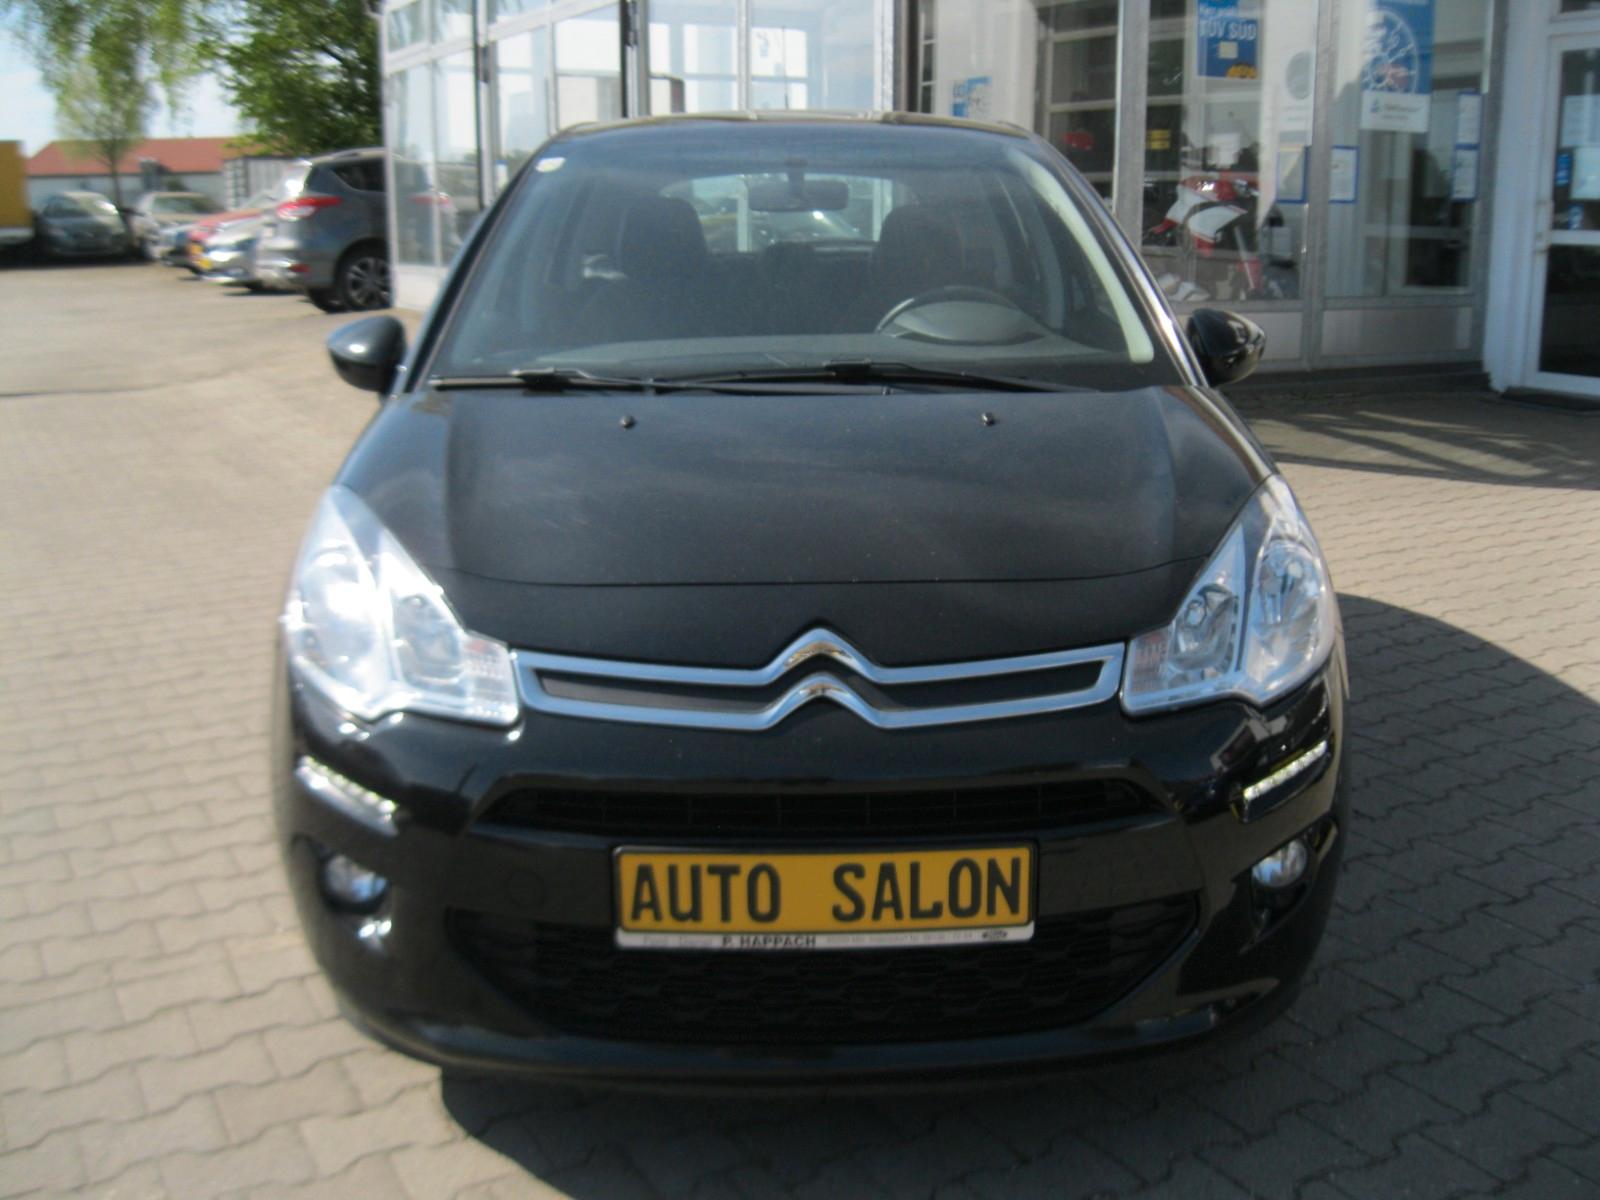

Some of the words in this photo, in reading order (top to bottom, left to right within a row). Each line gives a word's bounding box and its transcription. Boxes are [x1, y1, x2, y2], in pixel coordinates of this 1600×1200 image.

[631, 863, 781, 924] AUTO
[832, 857, 1021, 922] SALON
[741, 935, 817, 949] HAPPACH
